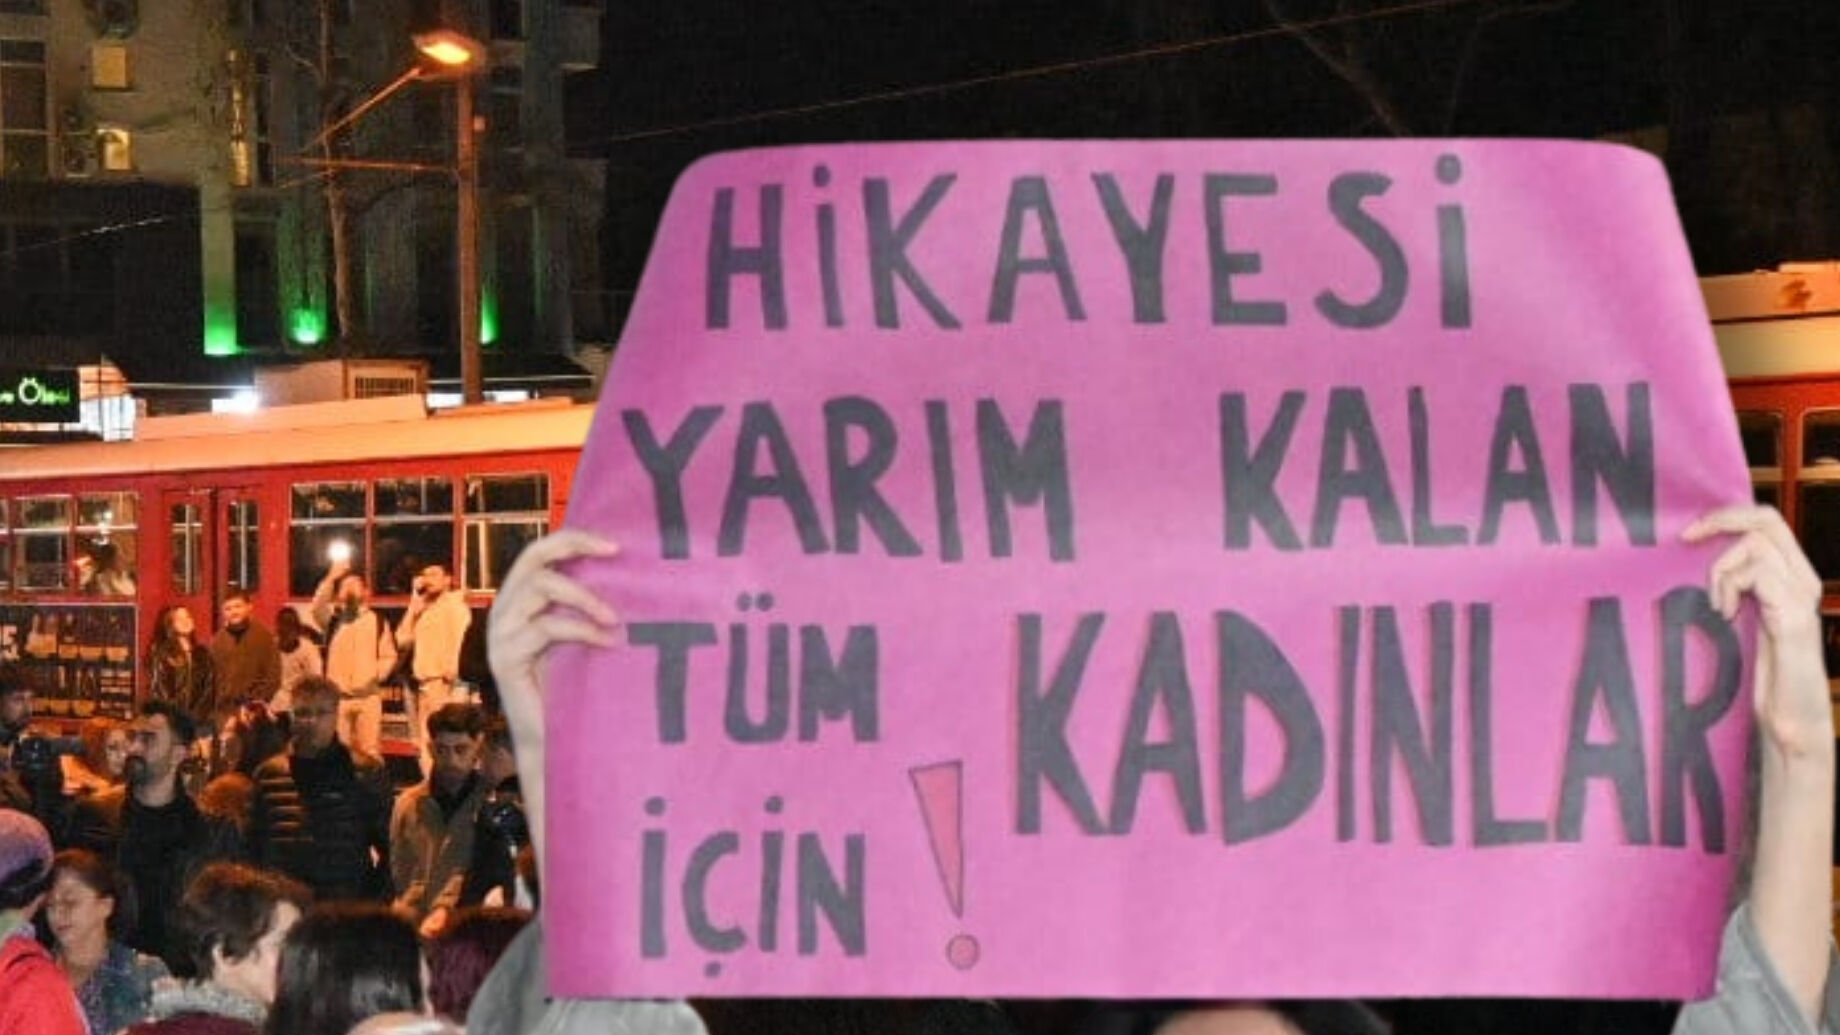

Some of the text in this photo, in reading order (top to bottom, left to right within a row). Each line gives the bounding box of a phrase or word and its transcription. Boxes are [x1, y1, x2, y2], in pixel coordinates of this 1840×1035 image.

[706, 157, 1472, 330] HİKAYESİ
[621, 384, 1656, 560] YARIM KALAN
[624, 585, 1742, 855] TÜM KADINLAR
[640, 796, 867, 978] İÇİN
